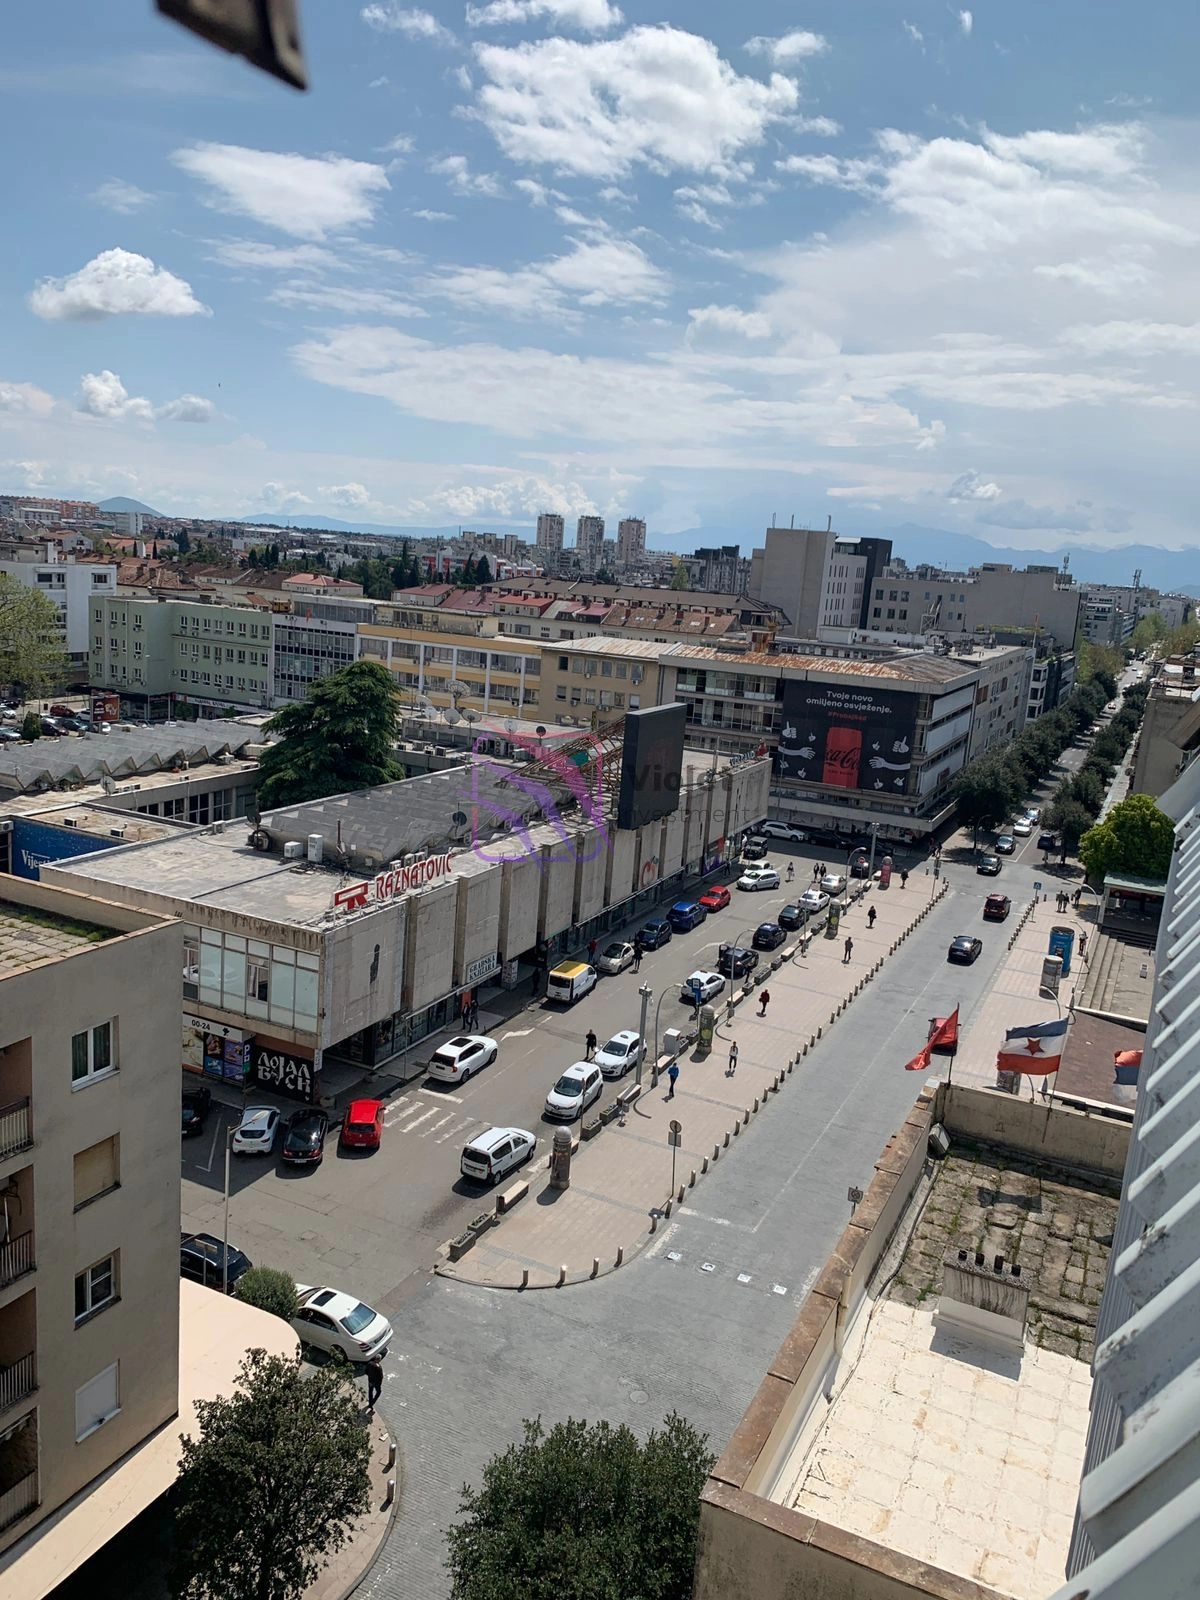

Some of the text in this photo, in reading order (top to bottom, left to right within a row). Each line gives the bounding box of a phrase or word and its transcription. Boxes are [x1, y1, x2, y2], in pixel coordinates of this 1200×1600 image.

[826, 690, 873, 702] Tvoje novo
[805, 697, 892, 714] omiljeno osvježenje.
[191, 1019, 211, 1031] 00-24
